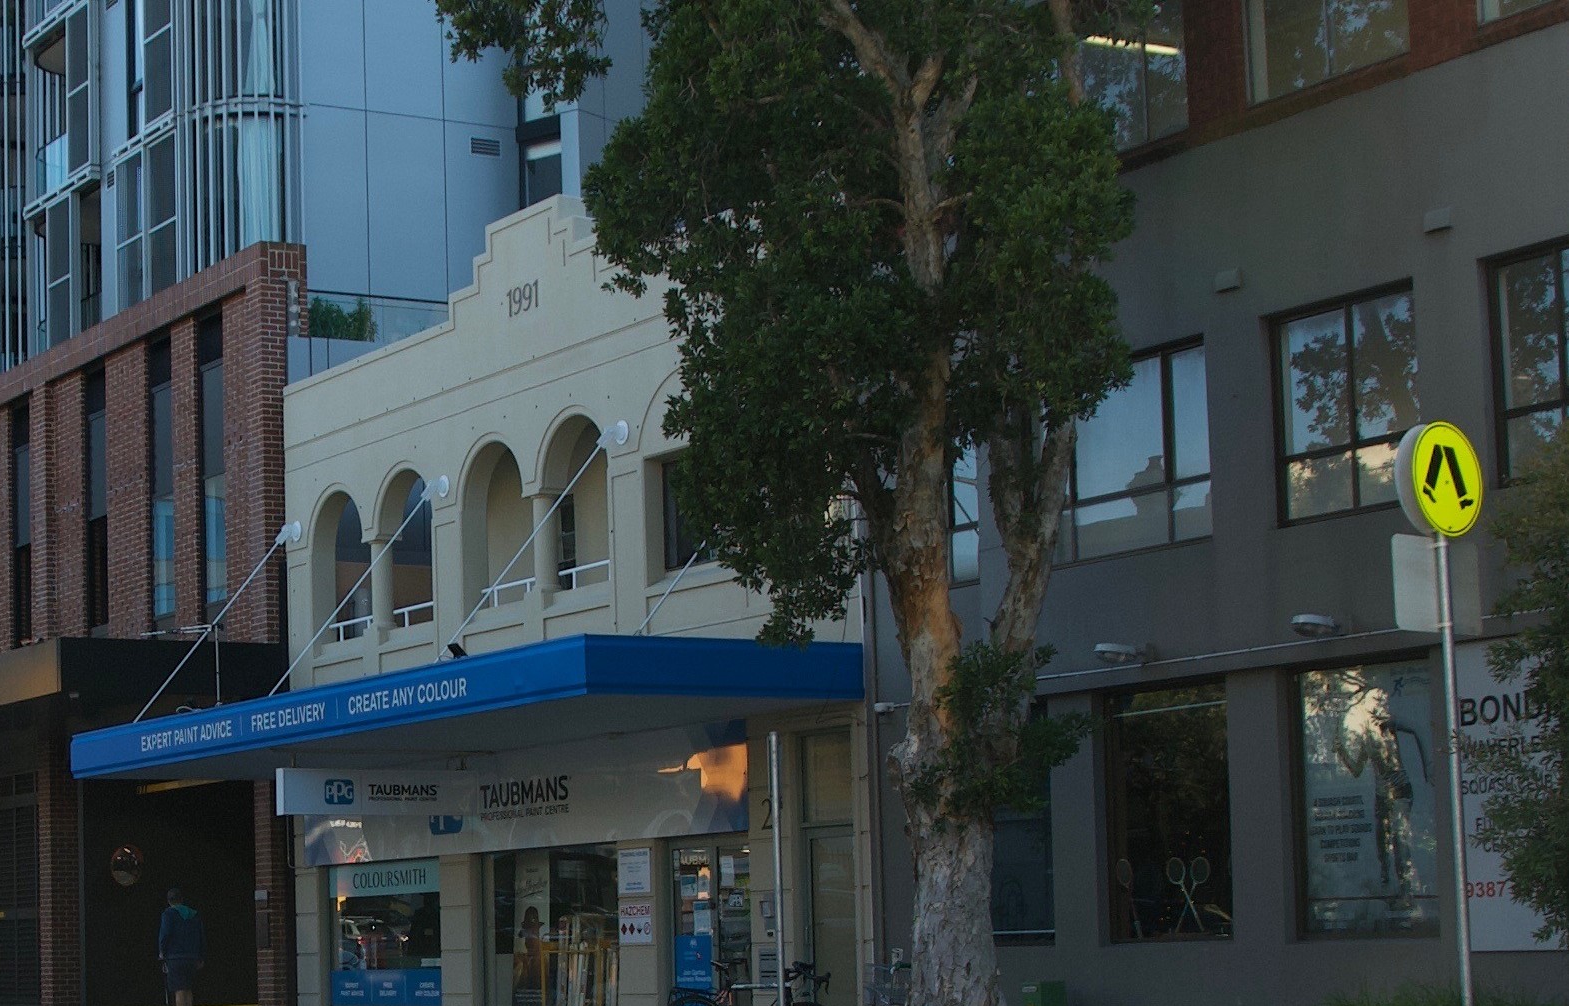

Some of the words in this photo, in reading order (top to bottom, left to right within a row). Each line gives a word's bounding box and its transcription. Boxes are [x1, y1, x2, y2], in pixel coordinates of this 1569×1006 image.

[506, 279, 538, 317] 1991
[347, 693, 390, 715] CREATE
[391, 685, 415, 707] ANY
[417, 677, 467, 704] COLOUR
[251, 712, 276, 733] FREE
[278, 701, 326, 727] DELIVERY
[141, 730, 172, 752] EXPERT
[173, 725, 198, 746] PAINT
[200, 719, 232, 741] ADVICE
[325, 781, 354, 803] PPG
[368, 784, 438, 796] TAUBMANS
[480, 775, 569, 809] TAUBMANS
[353, 868, 426, 889] COLOURSMITH
